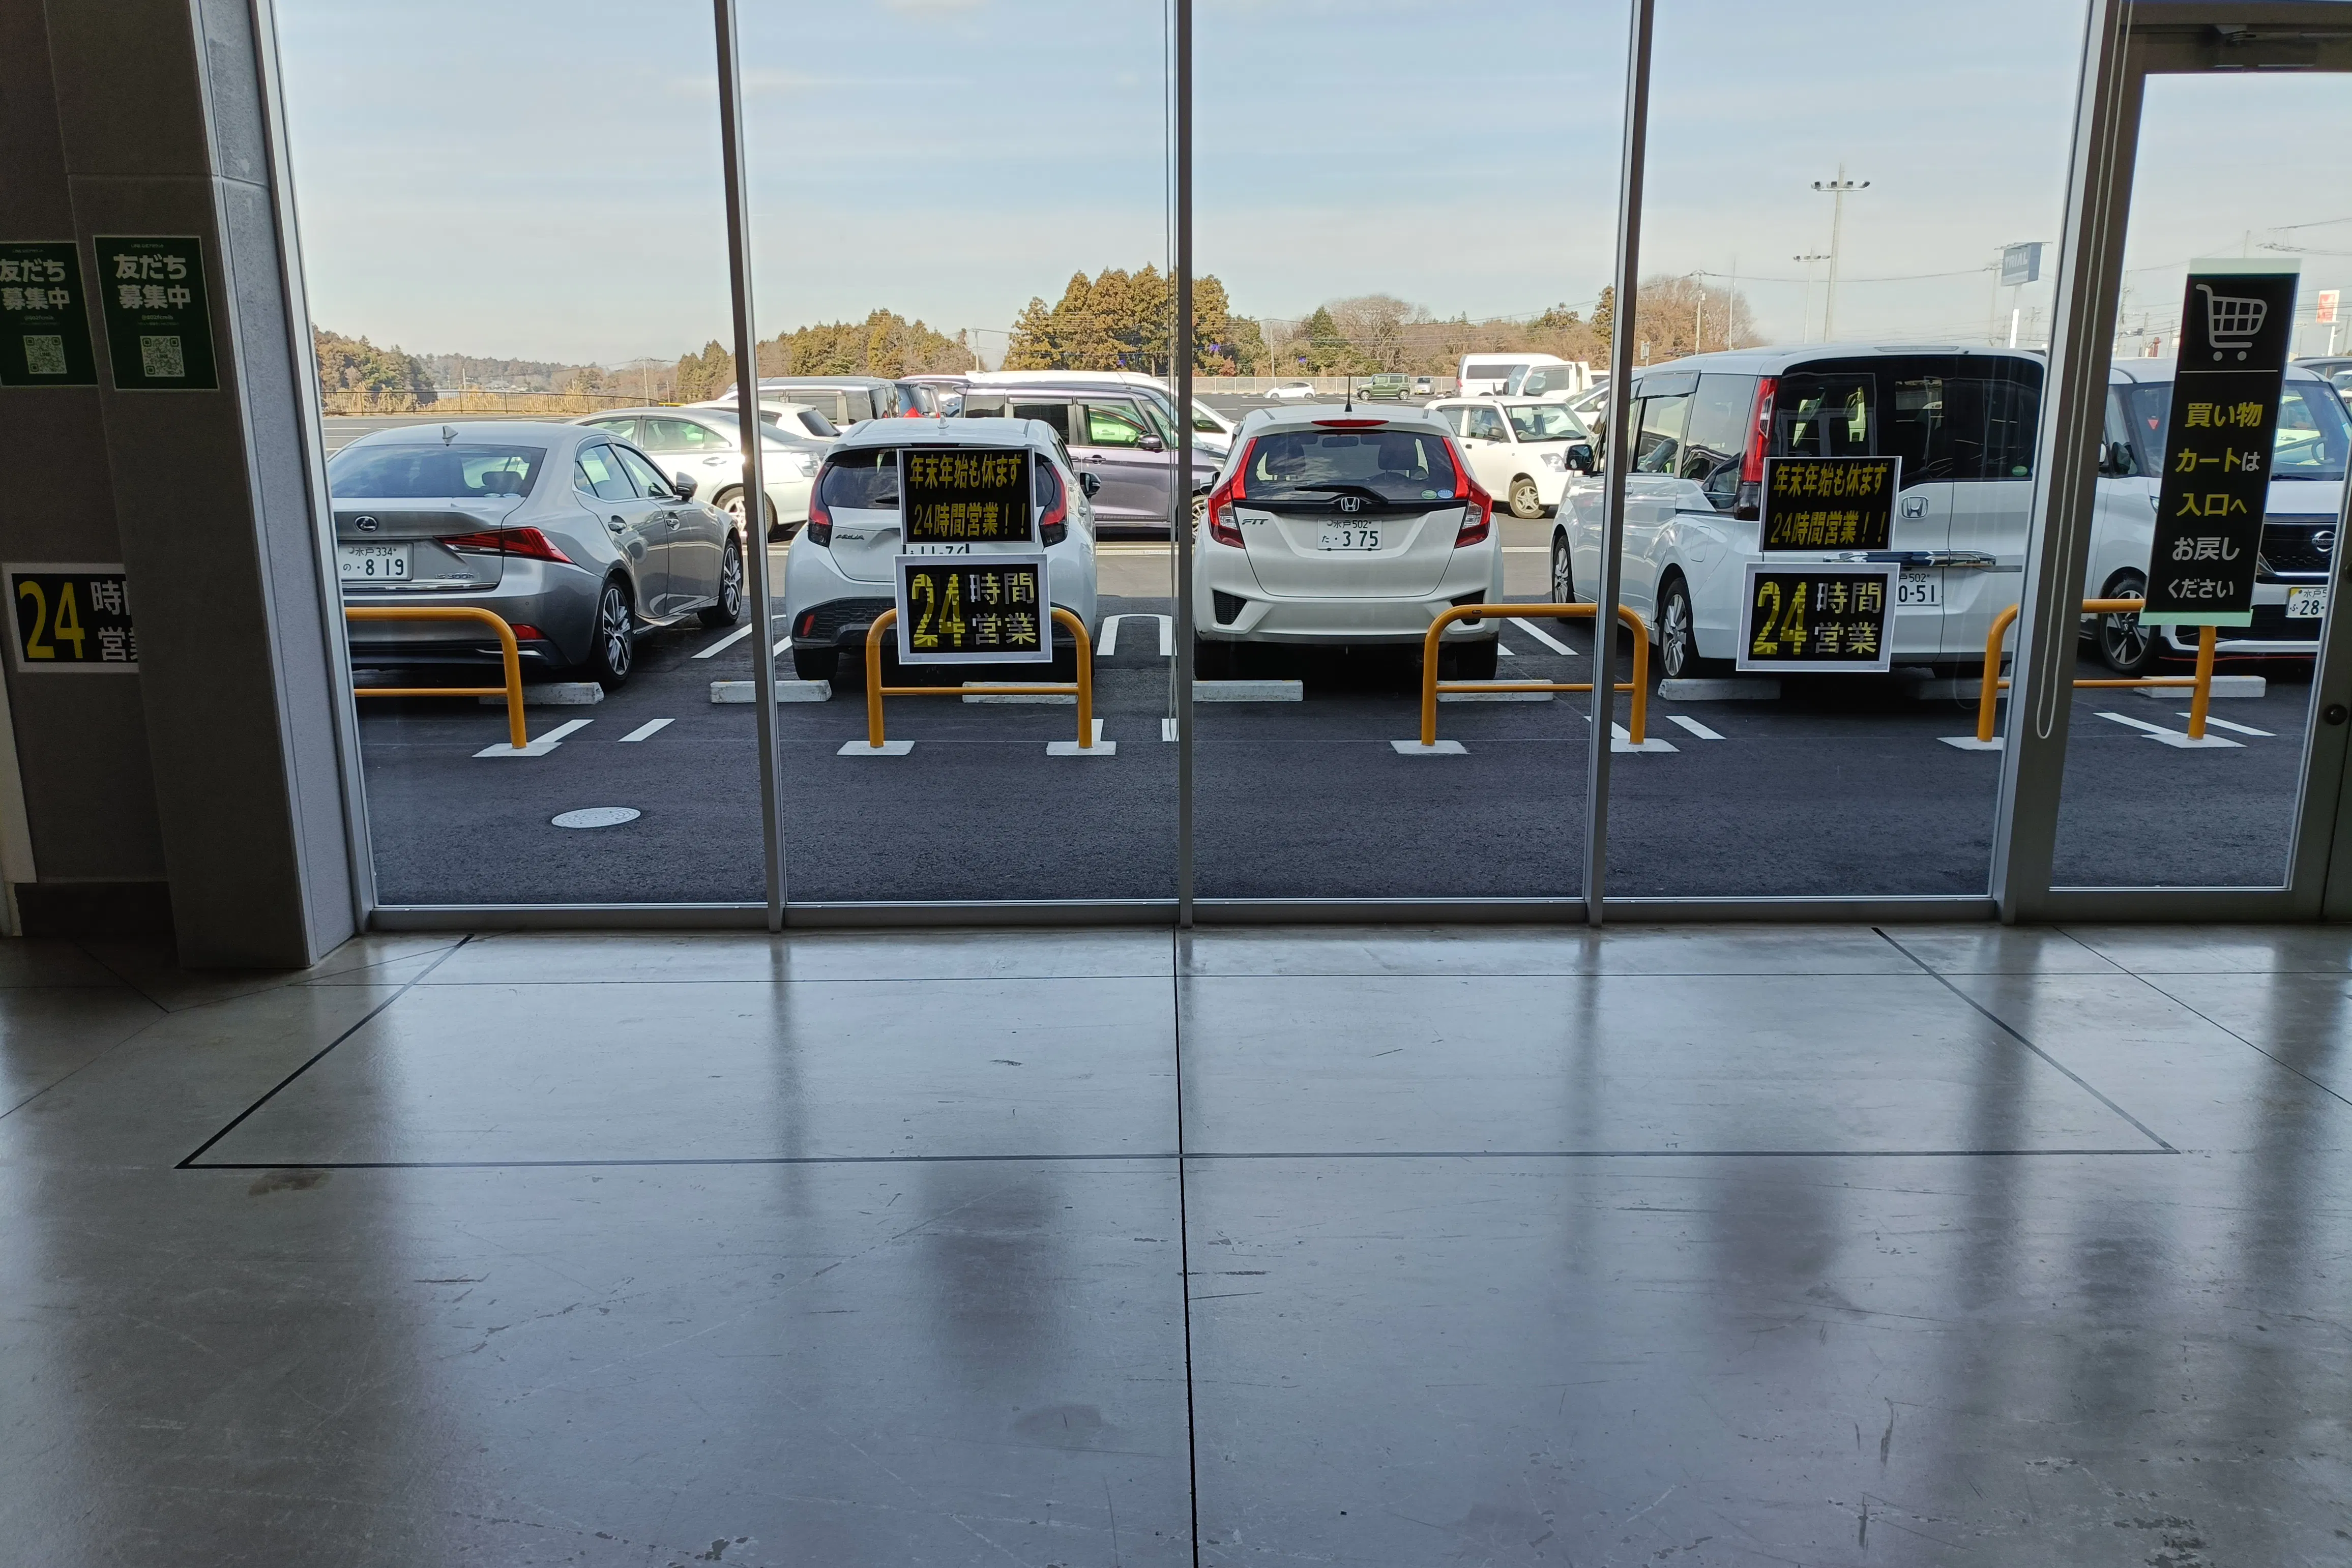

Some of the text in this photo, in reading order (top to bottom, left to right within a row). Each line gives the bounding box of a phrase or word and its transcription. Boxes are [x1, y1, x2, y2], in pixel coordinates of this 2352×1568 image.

[0, 258, 66, 282] 友だち
[113, 254, 187, 279] 友だち
[2005, 252, 2028, 270] TRIAL
[1, 287, 70, 310] 募集中
[117, 285, 191, 309] 募集中
[2185, 402, 2263, 427] 買い物
[909, 454, 1022, 489] 年末年始も休まず
[2175, 448, 2260, 472] カートは
[1773, 462, 1889, 497] 年末年始も休まず
[2176, 493, 2247, 516] 入口へ
[2172, 537, 2240, 560] お戻し
[2168, 578, 2233, 598] ください
[19, 580, 130, 658] 24 時
[912, 573, 1034, 647] 24 時間
[1752, 581, 1882, 655] 24 時間
[972, 612, 1036, 644] 営業
[1814, 622, 1878, 654] 営業
[98, 627, 138, 661] 営
